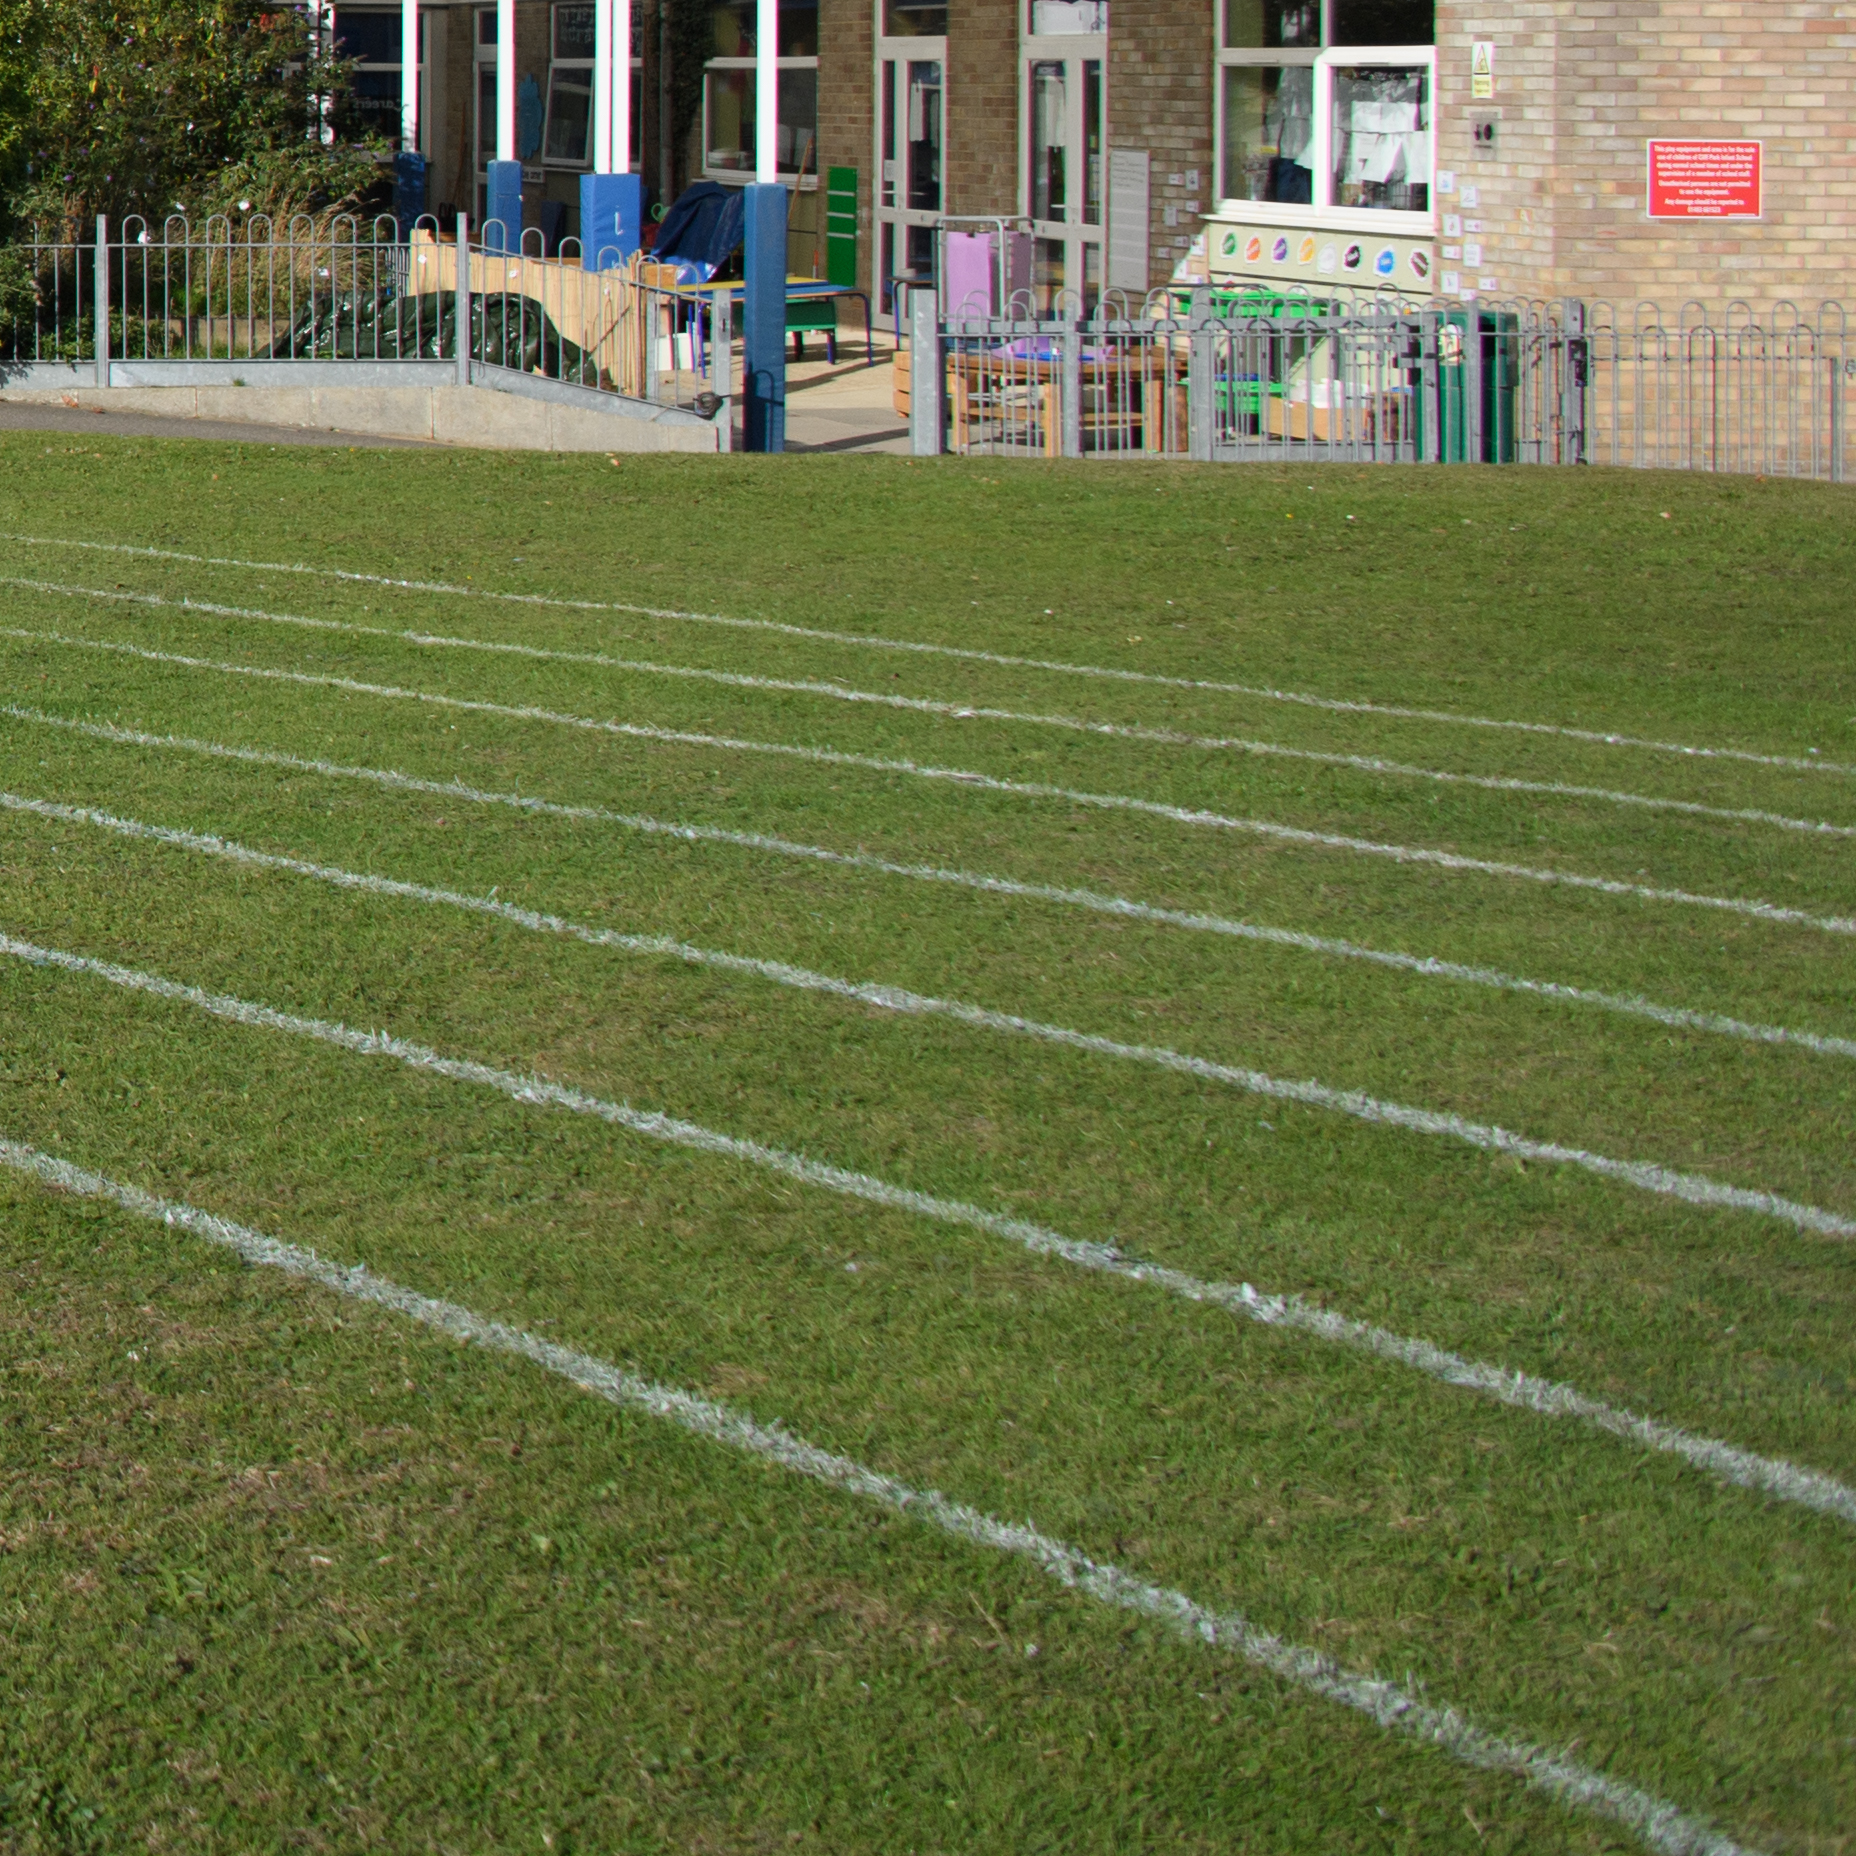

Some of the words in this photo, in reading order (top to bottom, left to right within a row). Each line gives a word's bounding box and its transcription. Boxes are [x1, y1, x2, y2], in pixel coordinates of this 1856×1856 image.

[1676, 145, 1701, 153] equipment
[1701, 145, 1710, 153] and
[1711, 145, 1722, 153] area
[1664, 198, 1674, 206] Any
[1675, 198, 1693, 206] damage
[1694, 198, 1710, 206] should
[1717, 198, 1738, 206] reported
